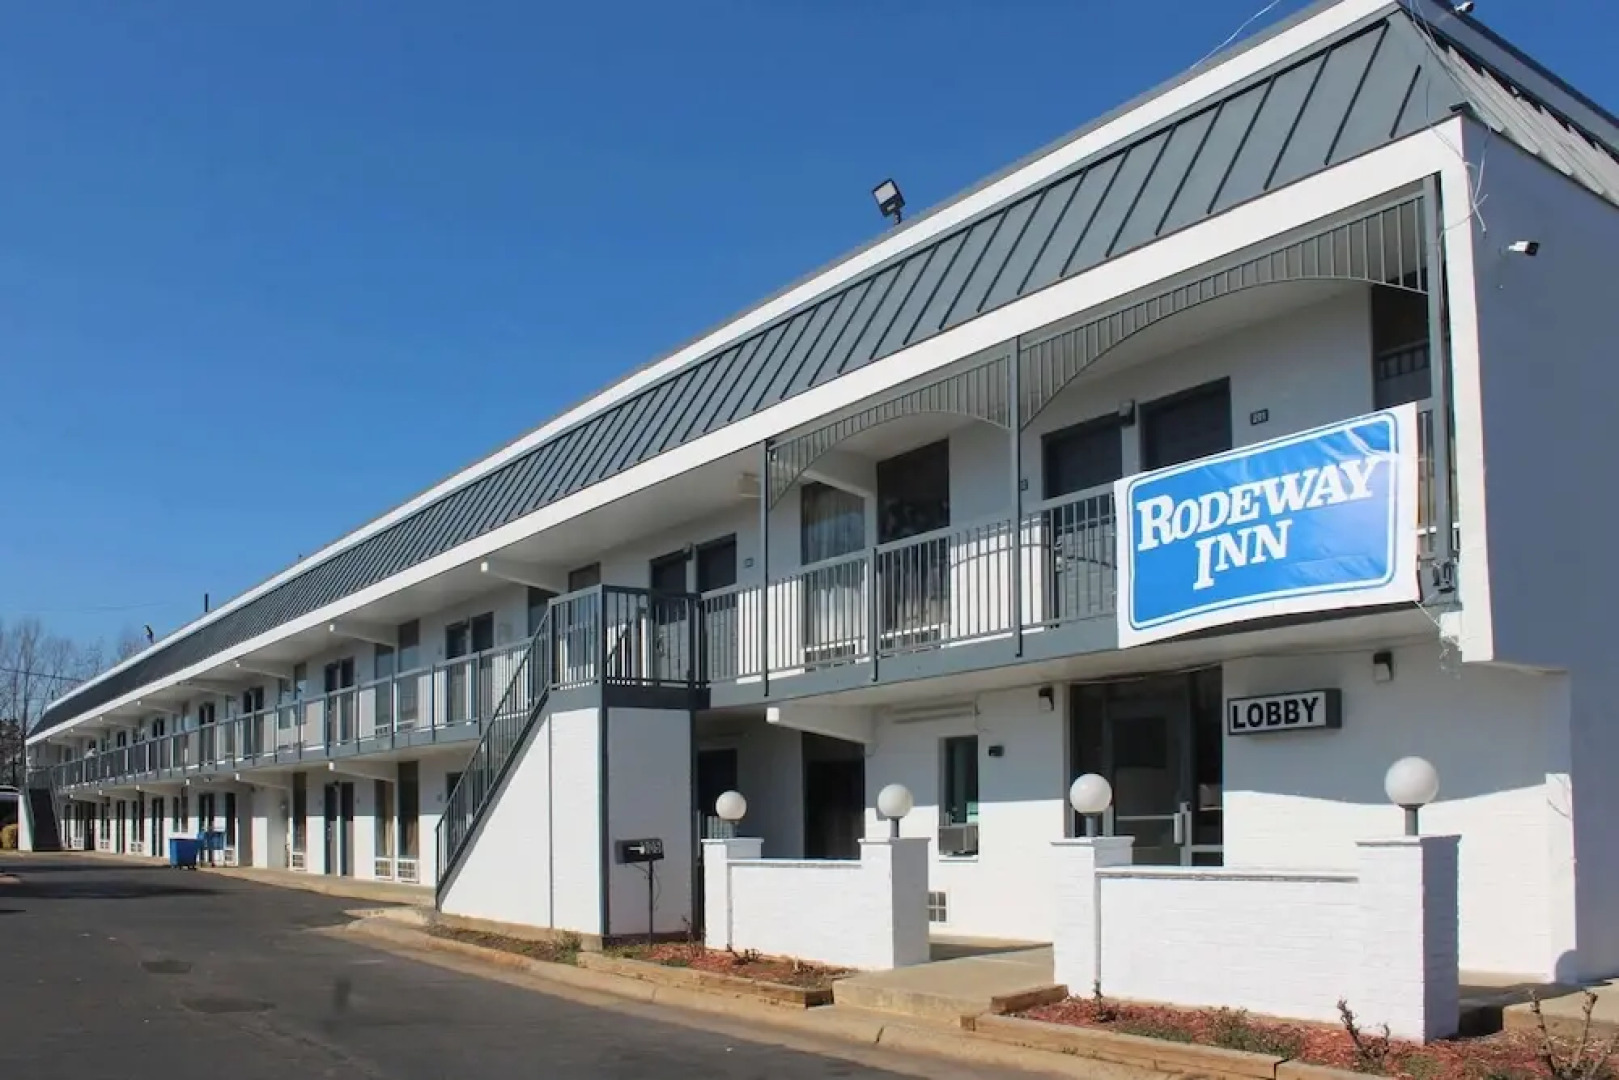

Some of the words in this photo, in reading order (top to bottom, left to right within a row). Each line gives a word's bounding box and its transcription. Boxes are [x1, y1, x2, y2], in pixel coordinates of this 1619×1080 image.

[1136, 458, 1381, 552] RODEWAY
[1193, 518, 1292, 590] INN
[1232, 696, 1319, 729] LOBBY
